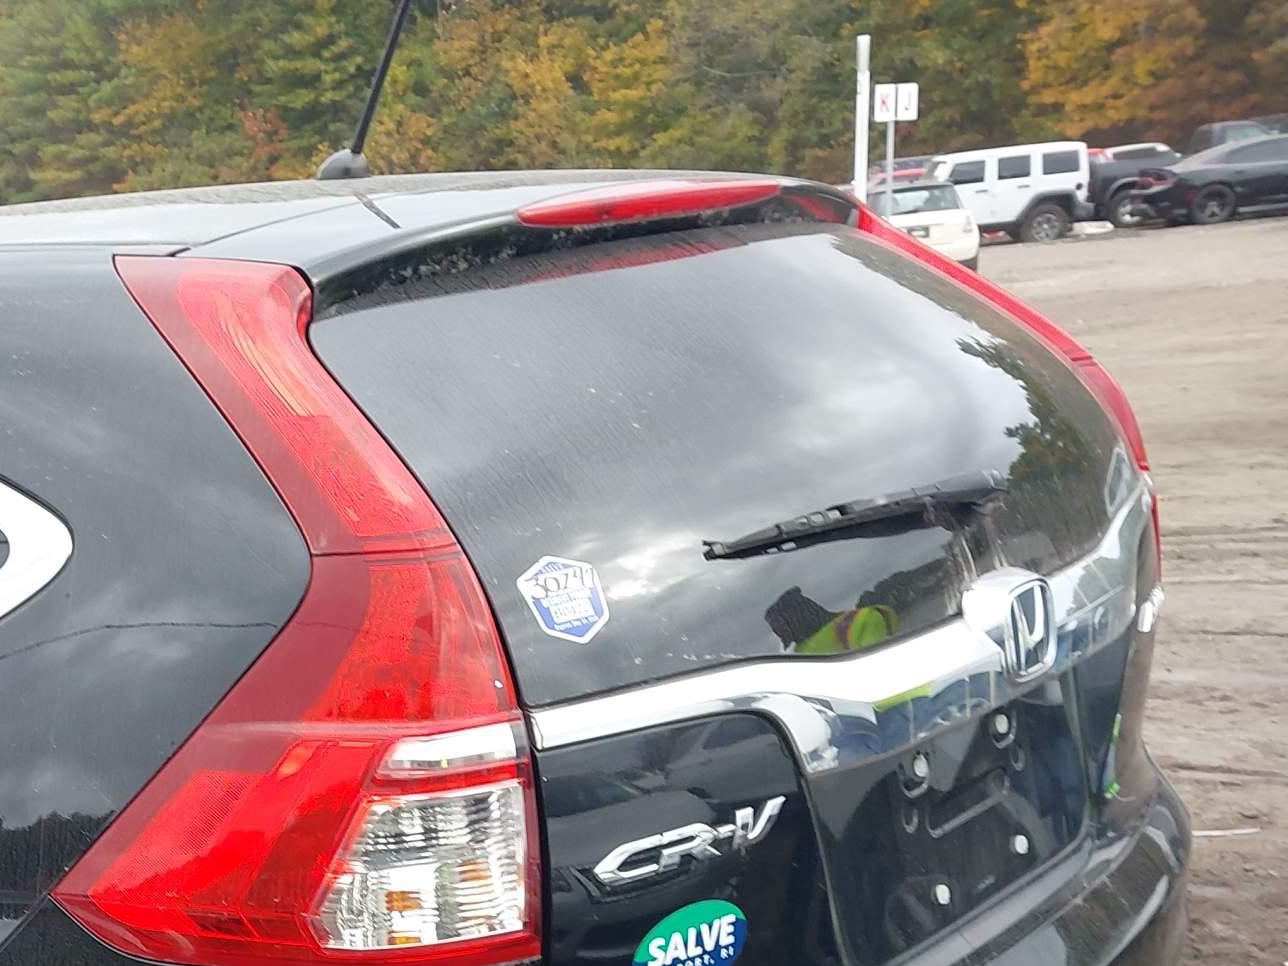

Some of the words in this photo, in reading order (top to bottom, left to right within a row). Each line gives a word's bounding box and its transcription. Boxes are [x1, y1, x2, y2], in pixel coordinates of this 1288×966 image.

[880, 92, 890, 112] K
[593, 796, 786, 886] CR-V
[720, 946, 734, 959] RI
